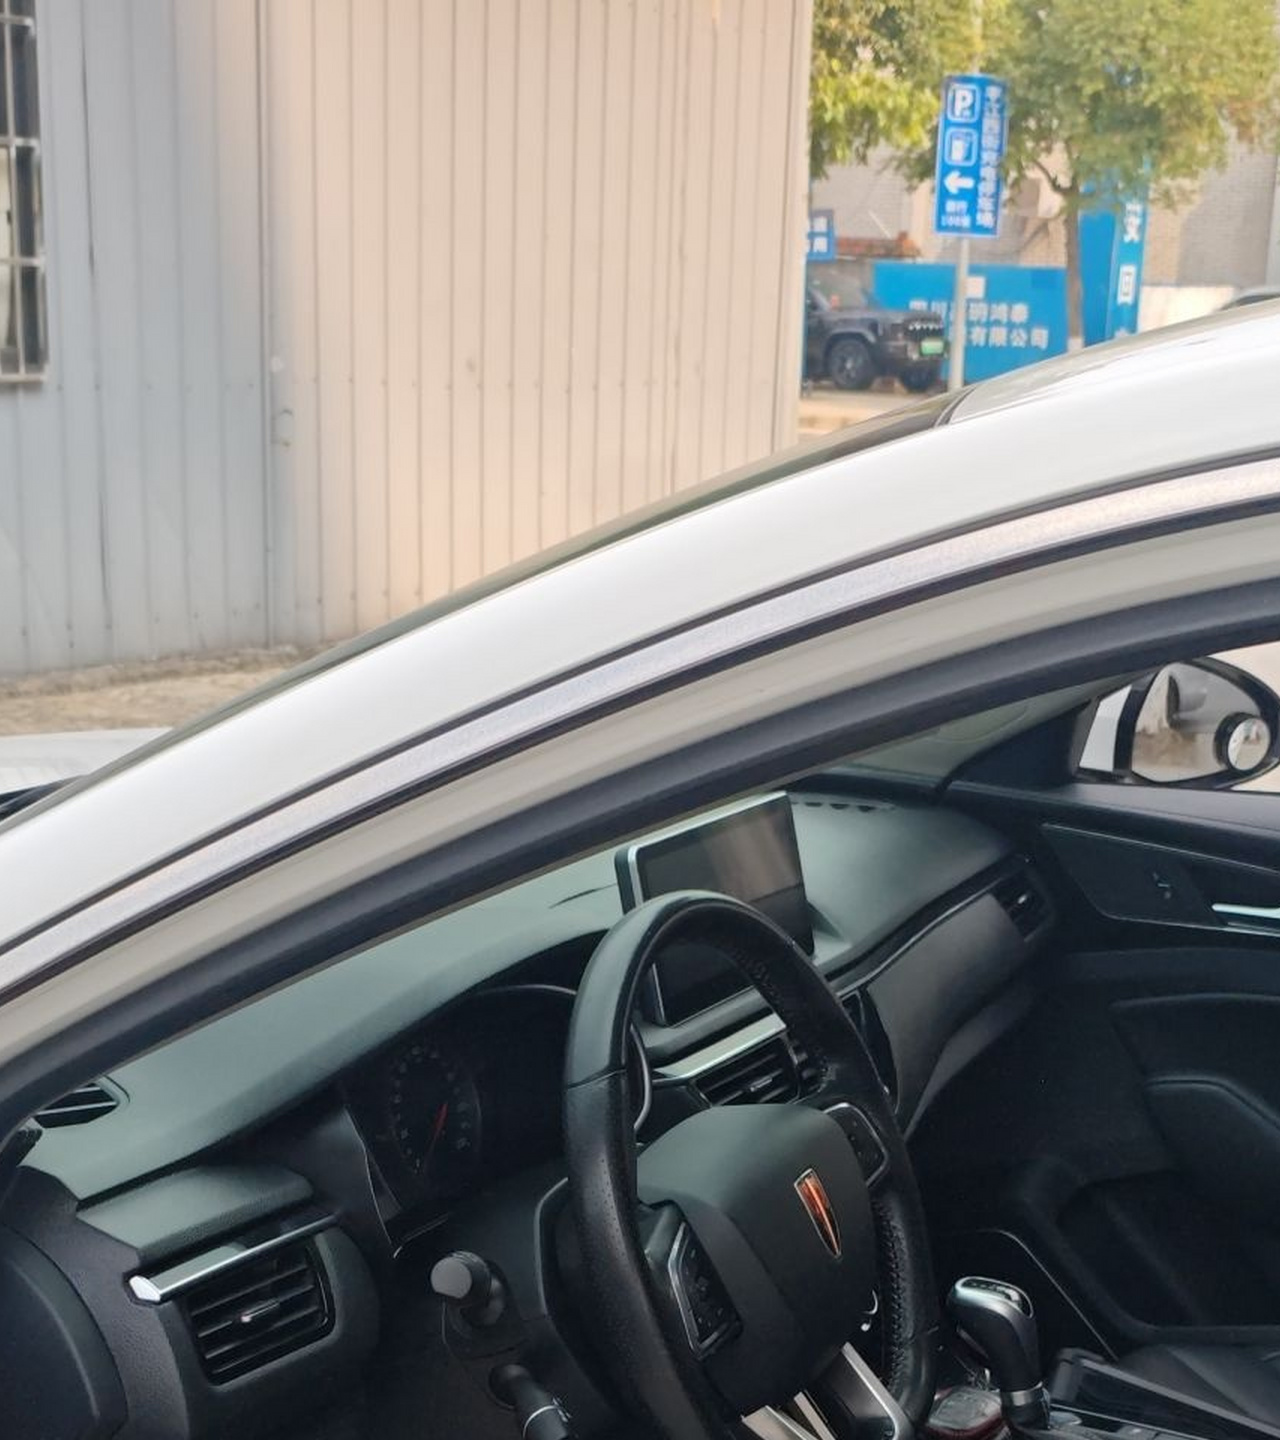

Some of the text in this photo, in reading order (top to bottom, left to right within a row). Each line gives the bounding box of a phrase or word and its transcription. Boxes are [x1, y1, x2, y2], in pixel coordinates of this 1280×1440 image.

[954, 88, 974, 116] P
[950, 325, 1049, 349] 有限公司
